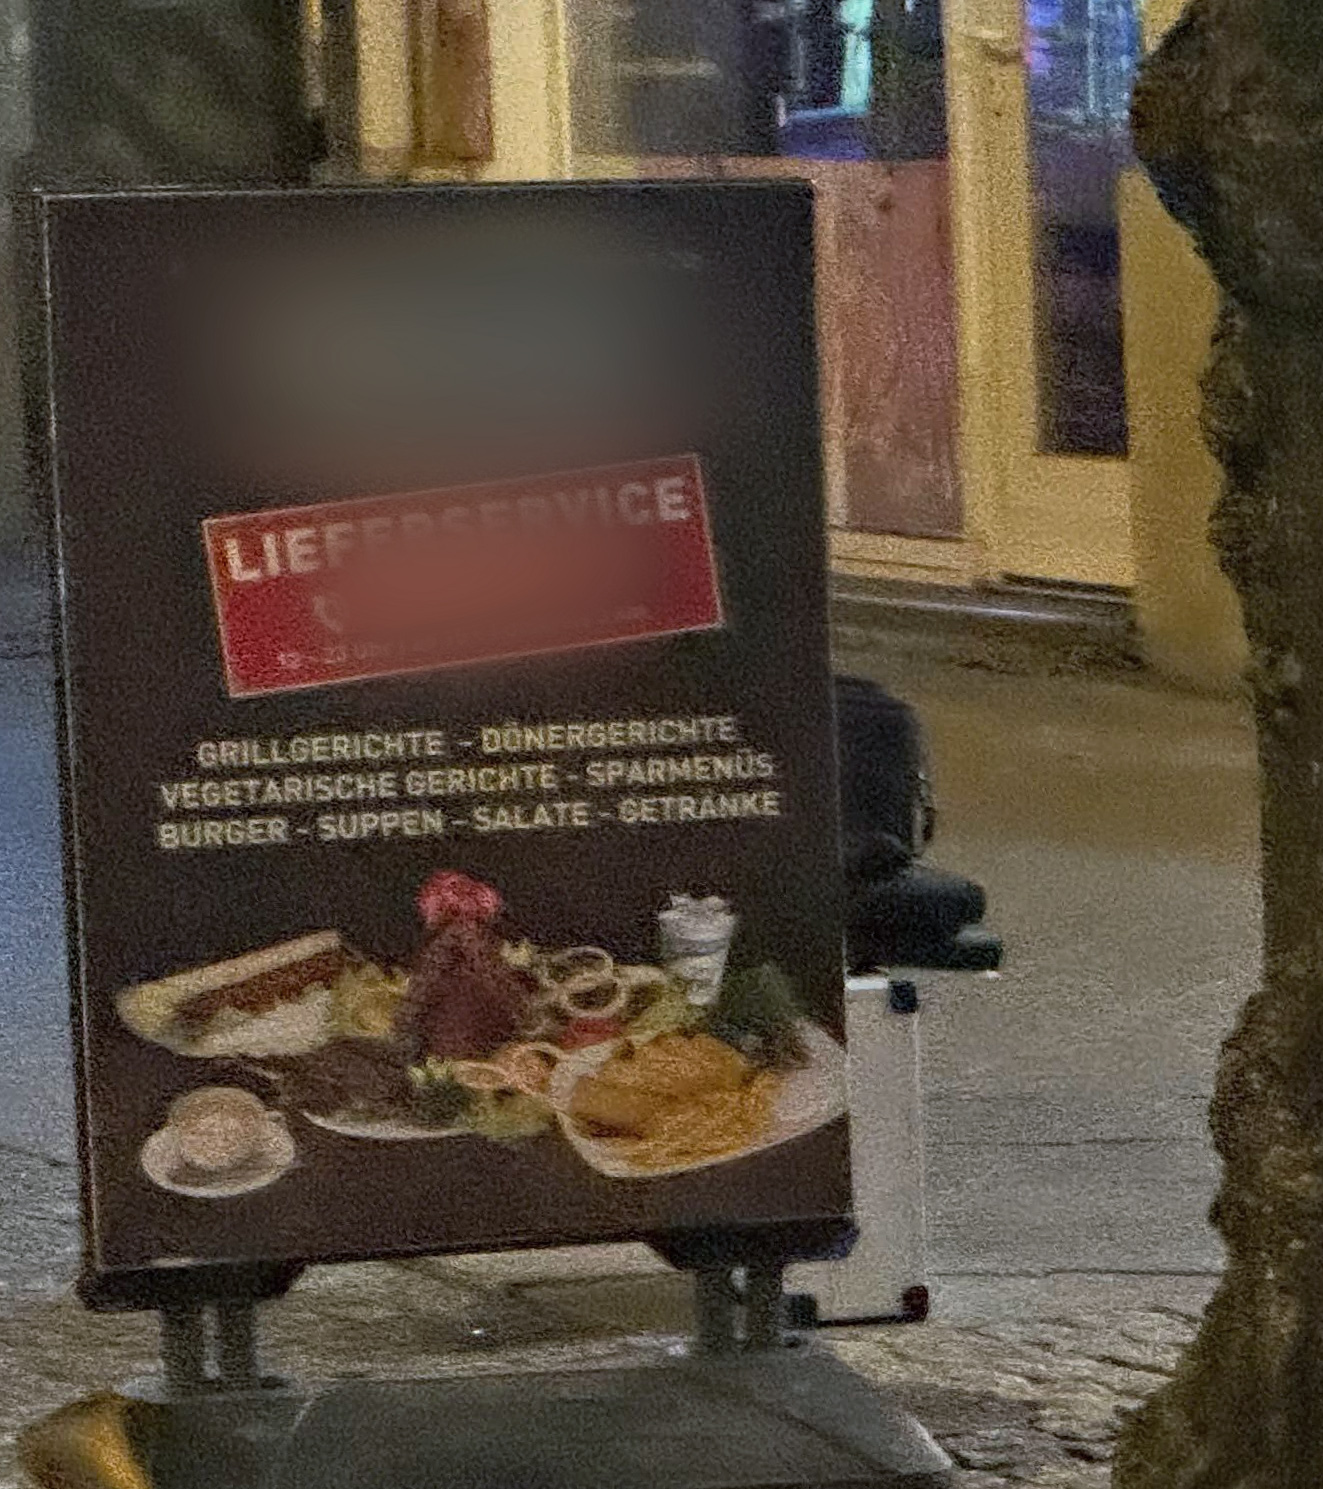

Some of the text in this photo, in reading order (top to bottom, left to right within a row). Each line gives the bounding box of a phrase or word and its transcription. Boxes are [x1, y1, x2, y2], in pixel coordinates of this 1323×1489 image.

[198, 730, 444, 768] GRILLGERICHTE
[480, 715, 738, 753] DÖNERGERICHTE
[160, 771, 399, 809] VEGETARISCHE
[405, 763, 556, 797] GERICHTE
[586, 748, 775, 787] SPARMENÜS
[159, 817, 289, 849] BURGER
[316, 810, 444, 841] SUPPEN
[472, 801, 590, 830] SALATE
